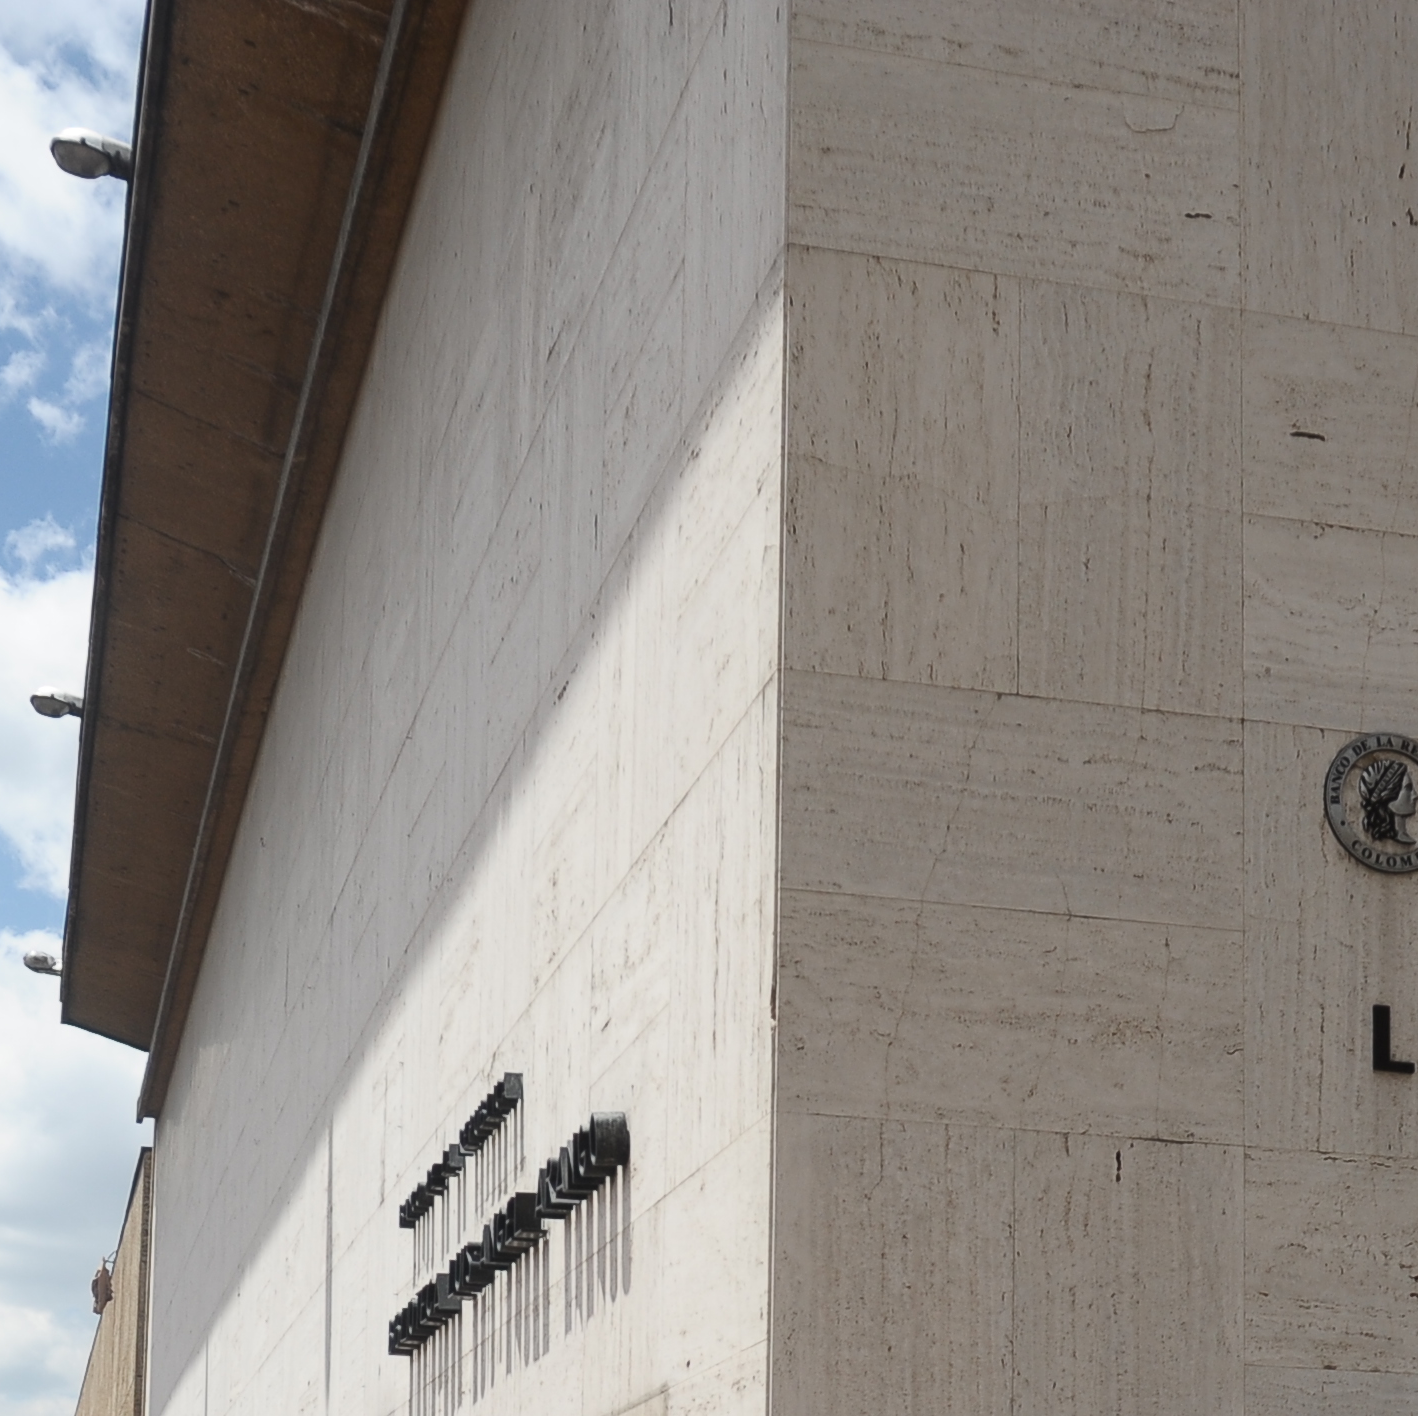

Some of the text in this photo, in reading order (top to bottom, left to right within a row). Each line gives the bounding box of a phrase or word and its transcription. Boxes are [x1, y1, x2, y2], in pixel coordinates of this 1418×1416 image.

[1330, 755, 1351, 805] BANCO
[1352, 740, 1372, 757] DE
[1376, 736, 1394, 748] LA
